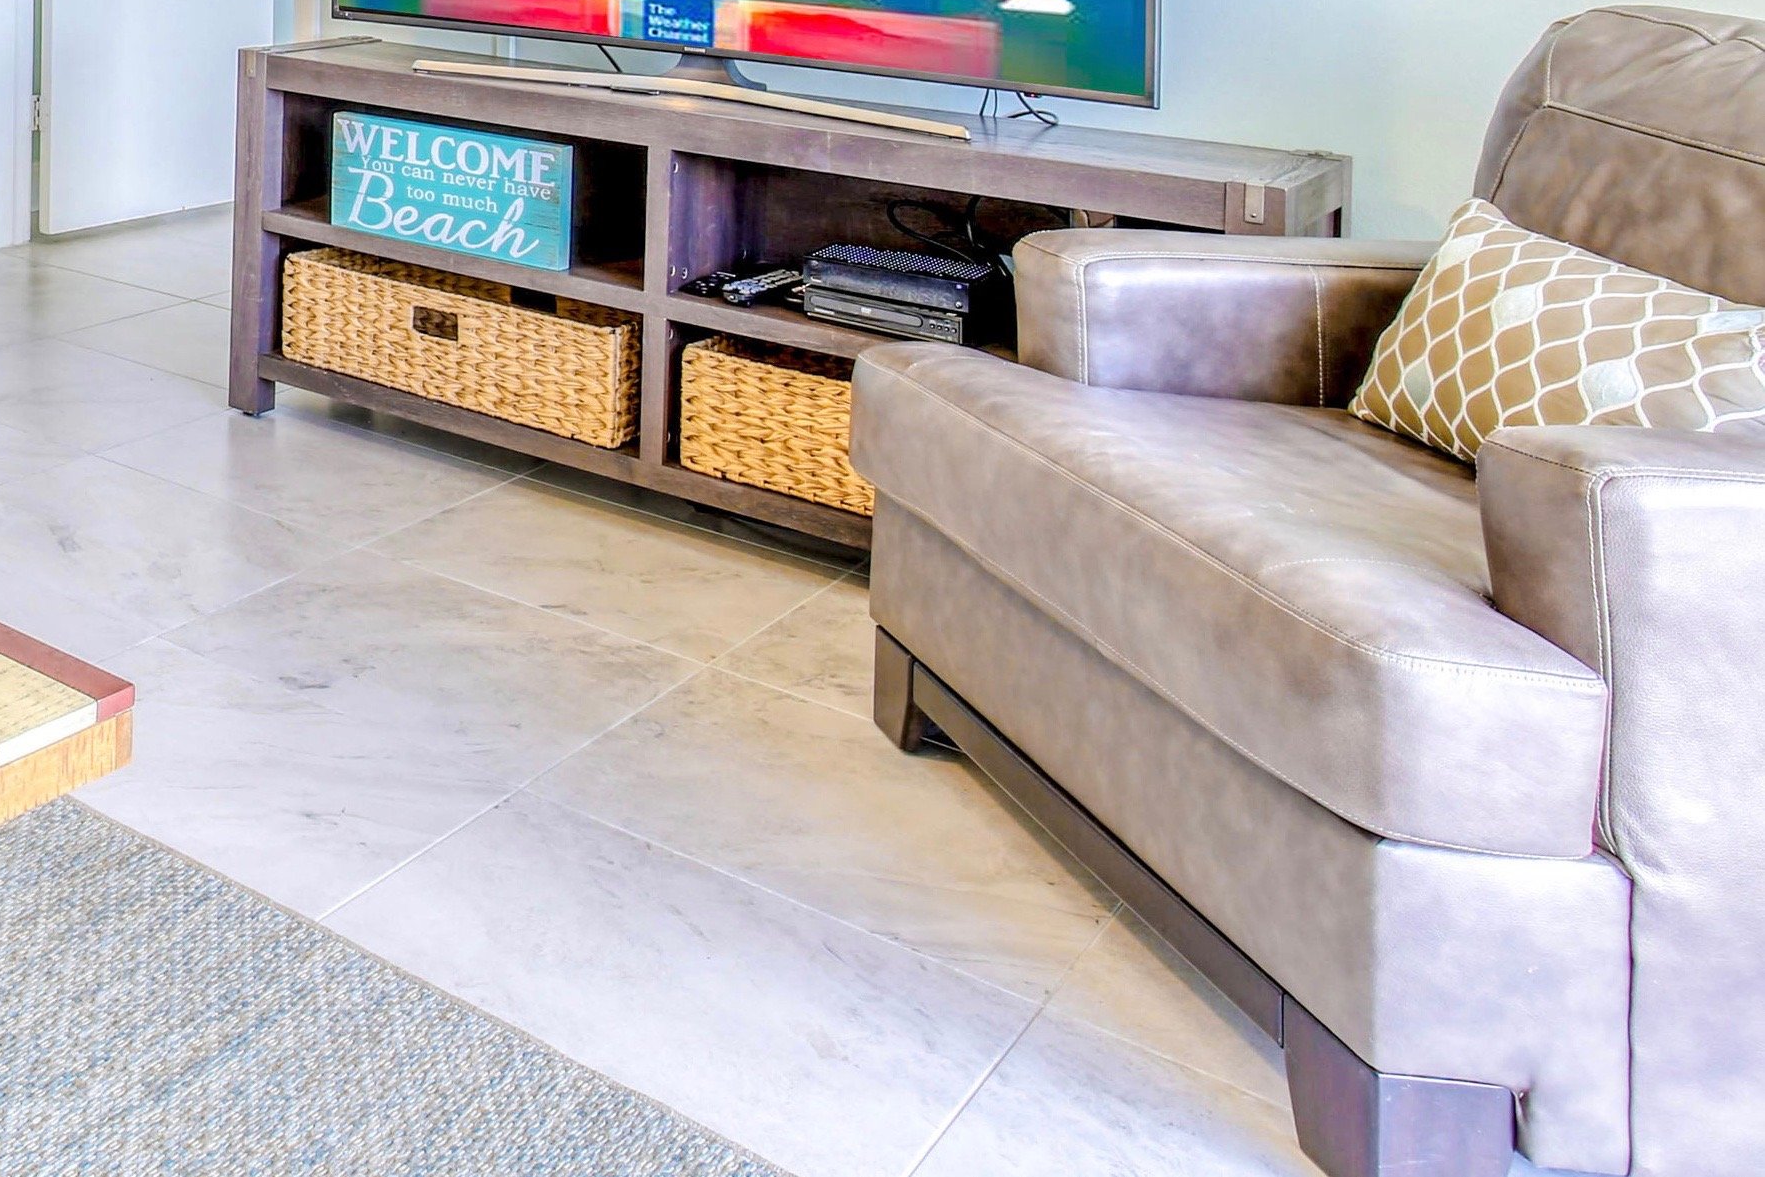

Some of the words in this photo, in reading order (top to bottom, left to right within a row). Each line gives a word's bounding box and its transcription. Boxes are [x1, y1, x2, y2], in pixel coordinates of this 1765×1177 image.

[648, 3, 677, 16] The
[648, 15, 710, 31] Weather
[648, 27, 709, 43] Channel
[337, 119, 555, 187] WELCOME
[361, 154, 395, 175] You
[401, 165, 435, 182] can
[442, 171, 497, 192] never
[503, 177, 552, 201] have
[348, 166, 539, 258] Beach
[406, 184, 435, 202] too
[442, 192, 499, 214] much
